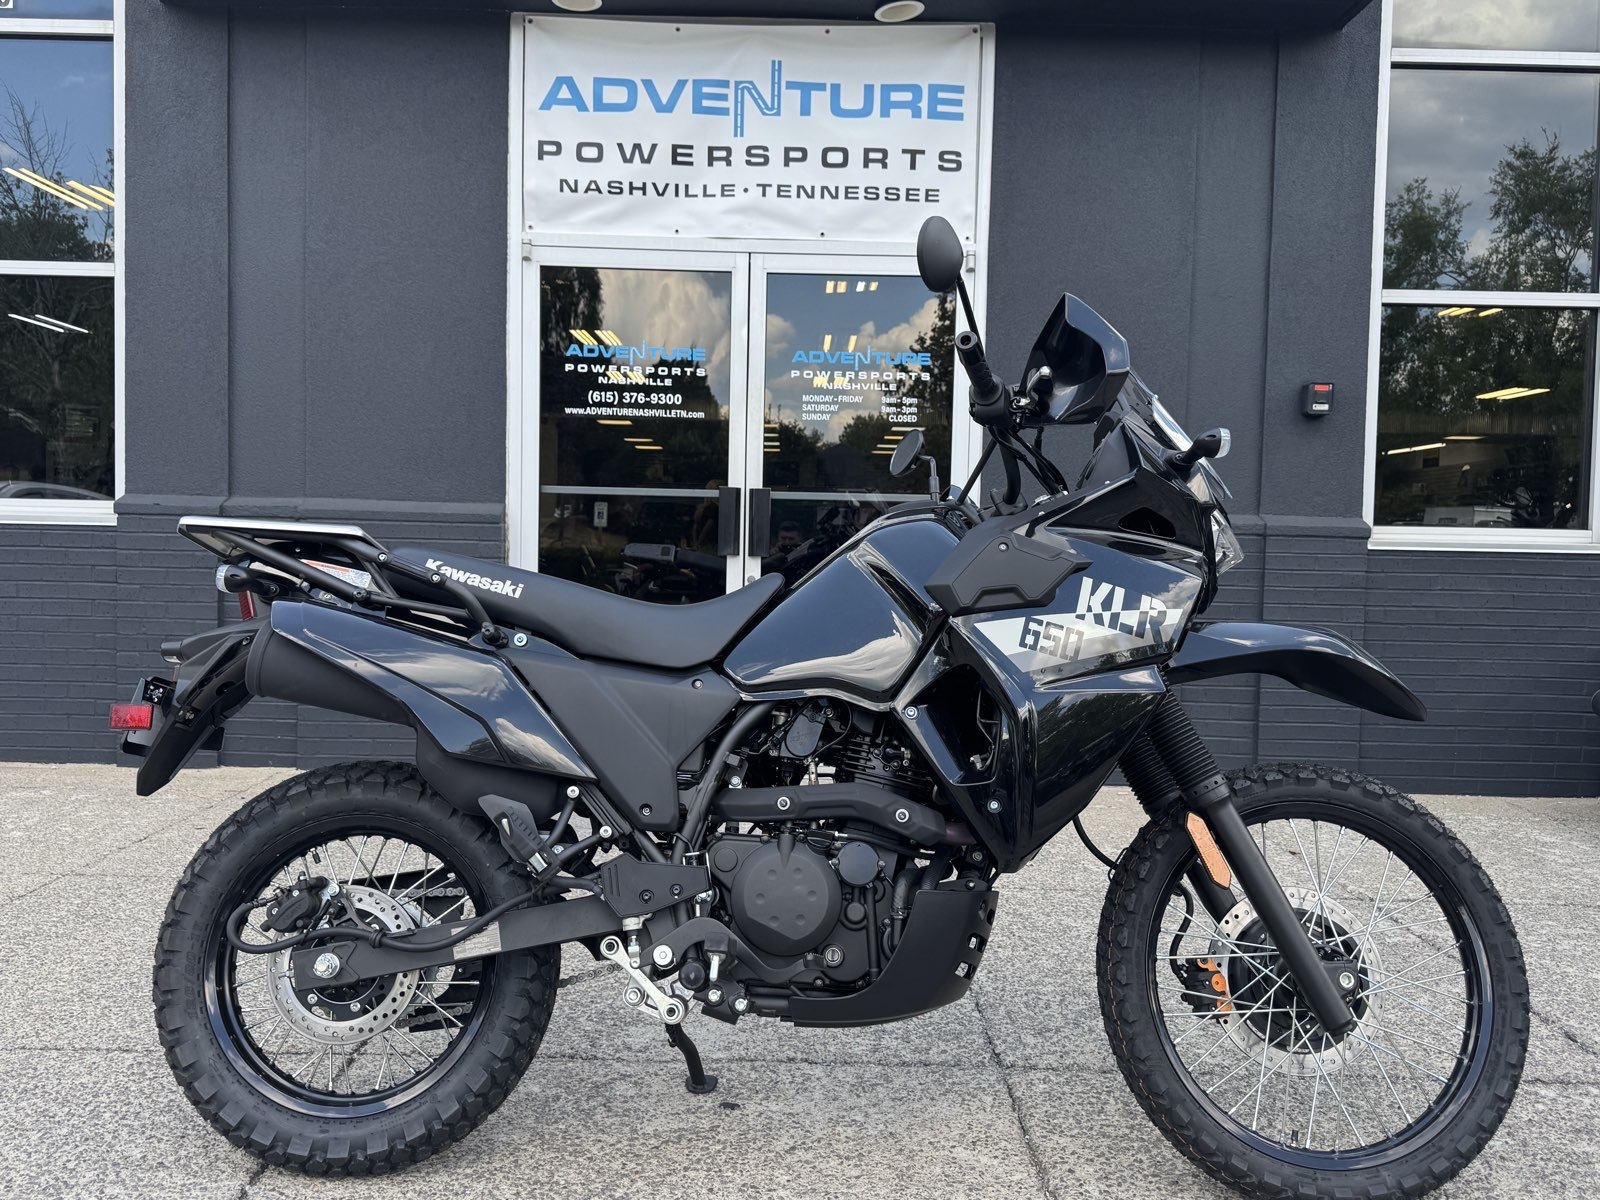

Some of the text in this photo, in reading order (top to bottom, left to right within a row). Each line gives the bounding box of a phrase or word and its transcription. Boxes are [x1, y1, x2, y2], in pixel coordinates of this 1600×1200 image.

[539, 60, 964, 137] ADVENTURE
[538, 140, 962, 172] POWERSPORTS
[559, 178, 940, 203] NASHVILLE TENNESSEE
[565, 340, 706, 365] ADVENTURE
[792, 345, 931, 371] ADVENTURE
[565, 363, 706, 377] POWERSPORTS
[791, 370, 931, 380] POWERSPORTS
[588, 390, 682, 405] (615) 376-9300
[824, 382, 897, 391] NASHVILLE
[564, 406, 705, 418] www.ADVENTURENASHVILLETN.com
[425, 558, 525, 599] Kawasaki
[1075, 576, 1167, 644] KLR
[1018, 617, 1085, 662] 650
